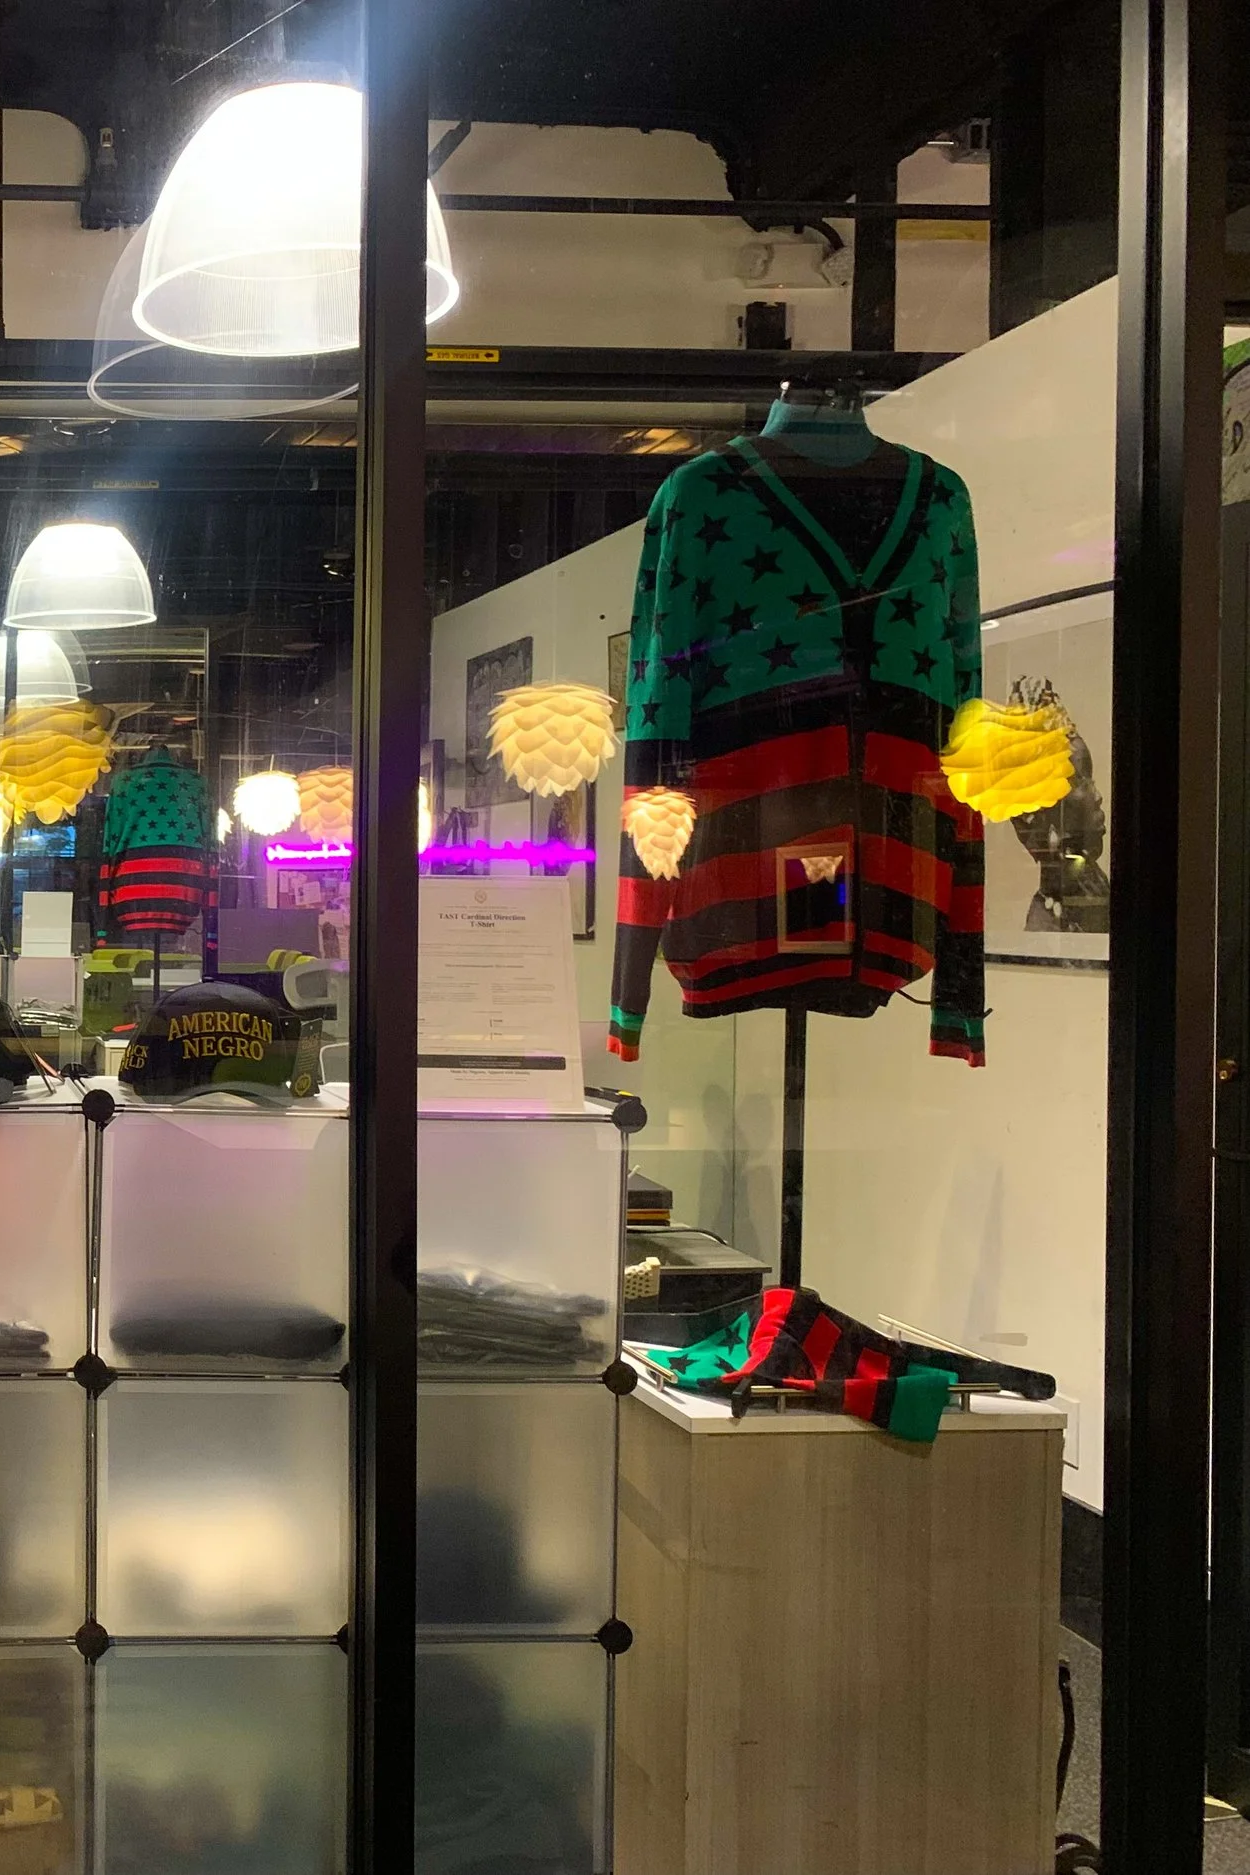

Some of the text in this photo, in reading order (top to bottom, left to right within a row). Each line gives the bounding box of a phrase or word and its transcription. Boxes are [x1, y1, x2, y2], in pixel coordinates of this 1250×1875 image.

[470, 920, 495, 928] T-Shirt
[167, 1011, 273, 1044] AMERICAN
[182, 1036, 265, 1061] NEGRO
